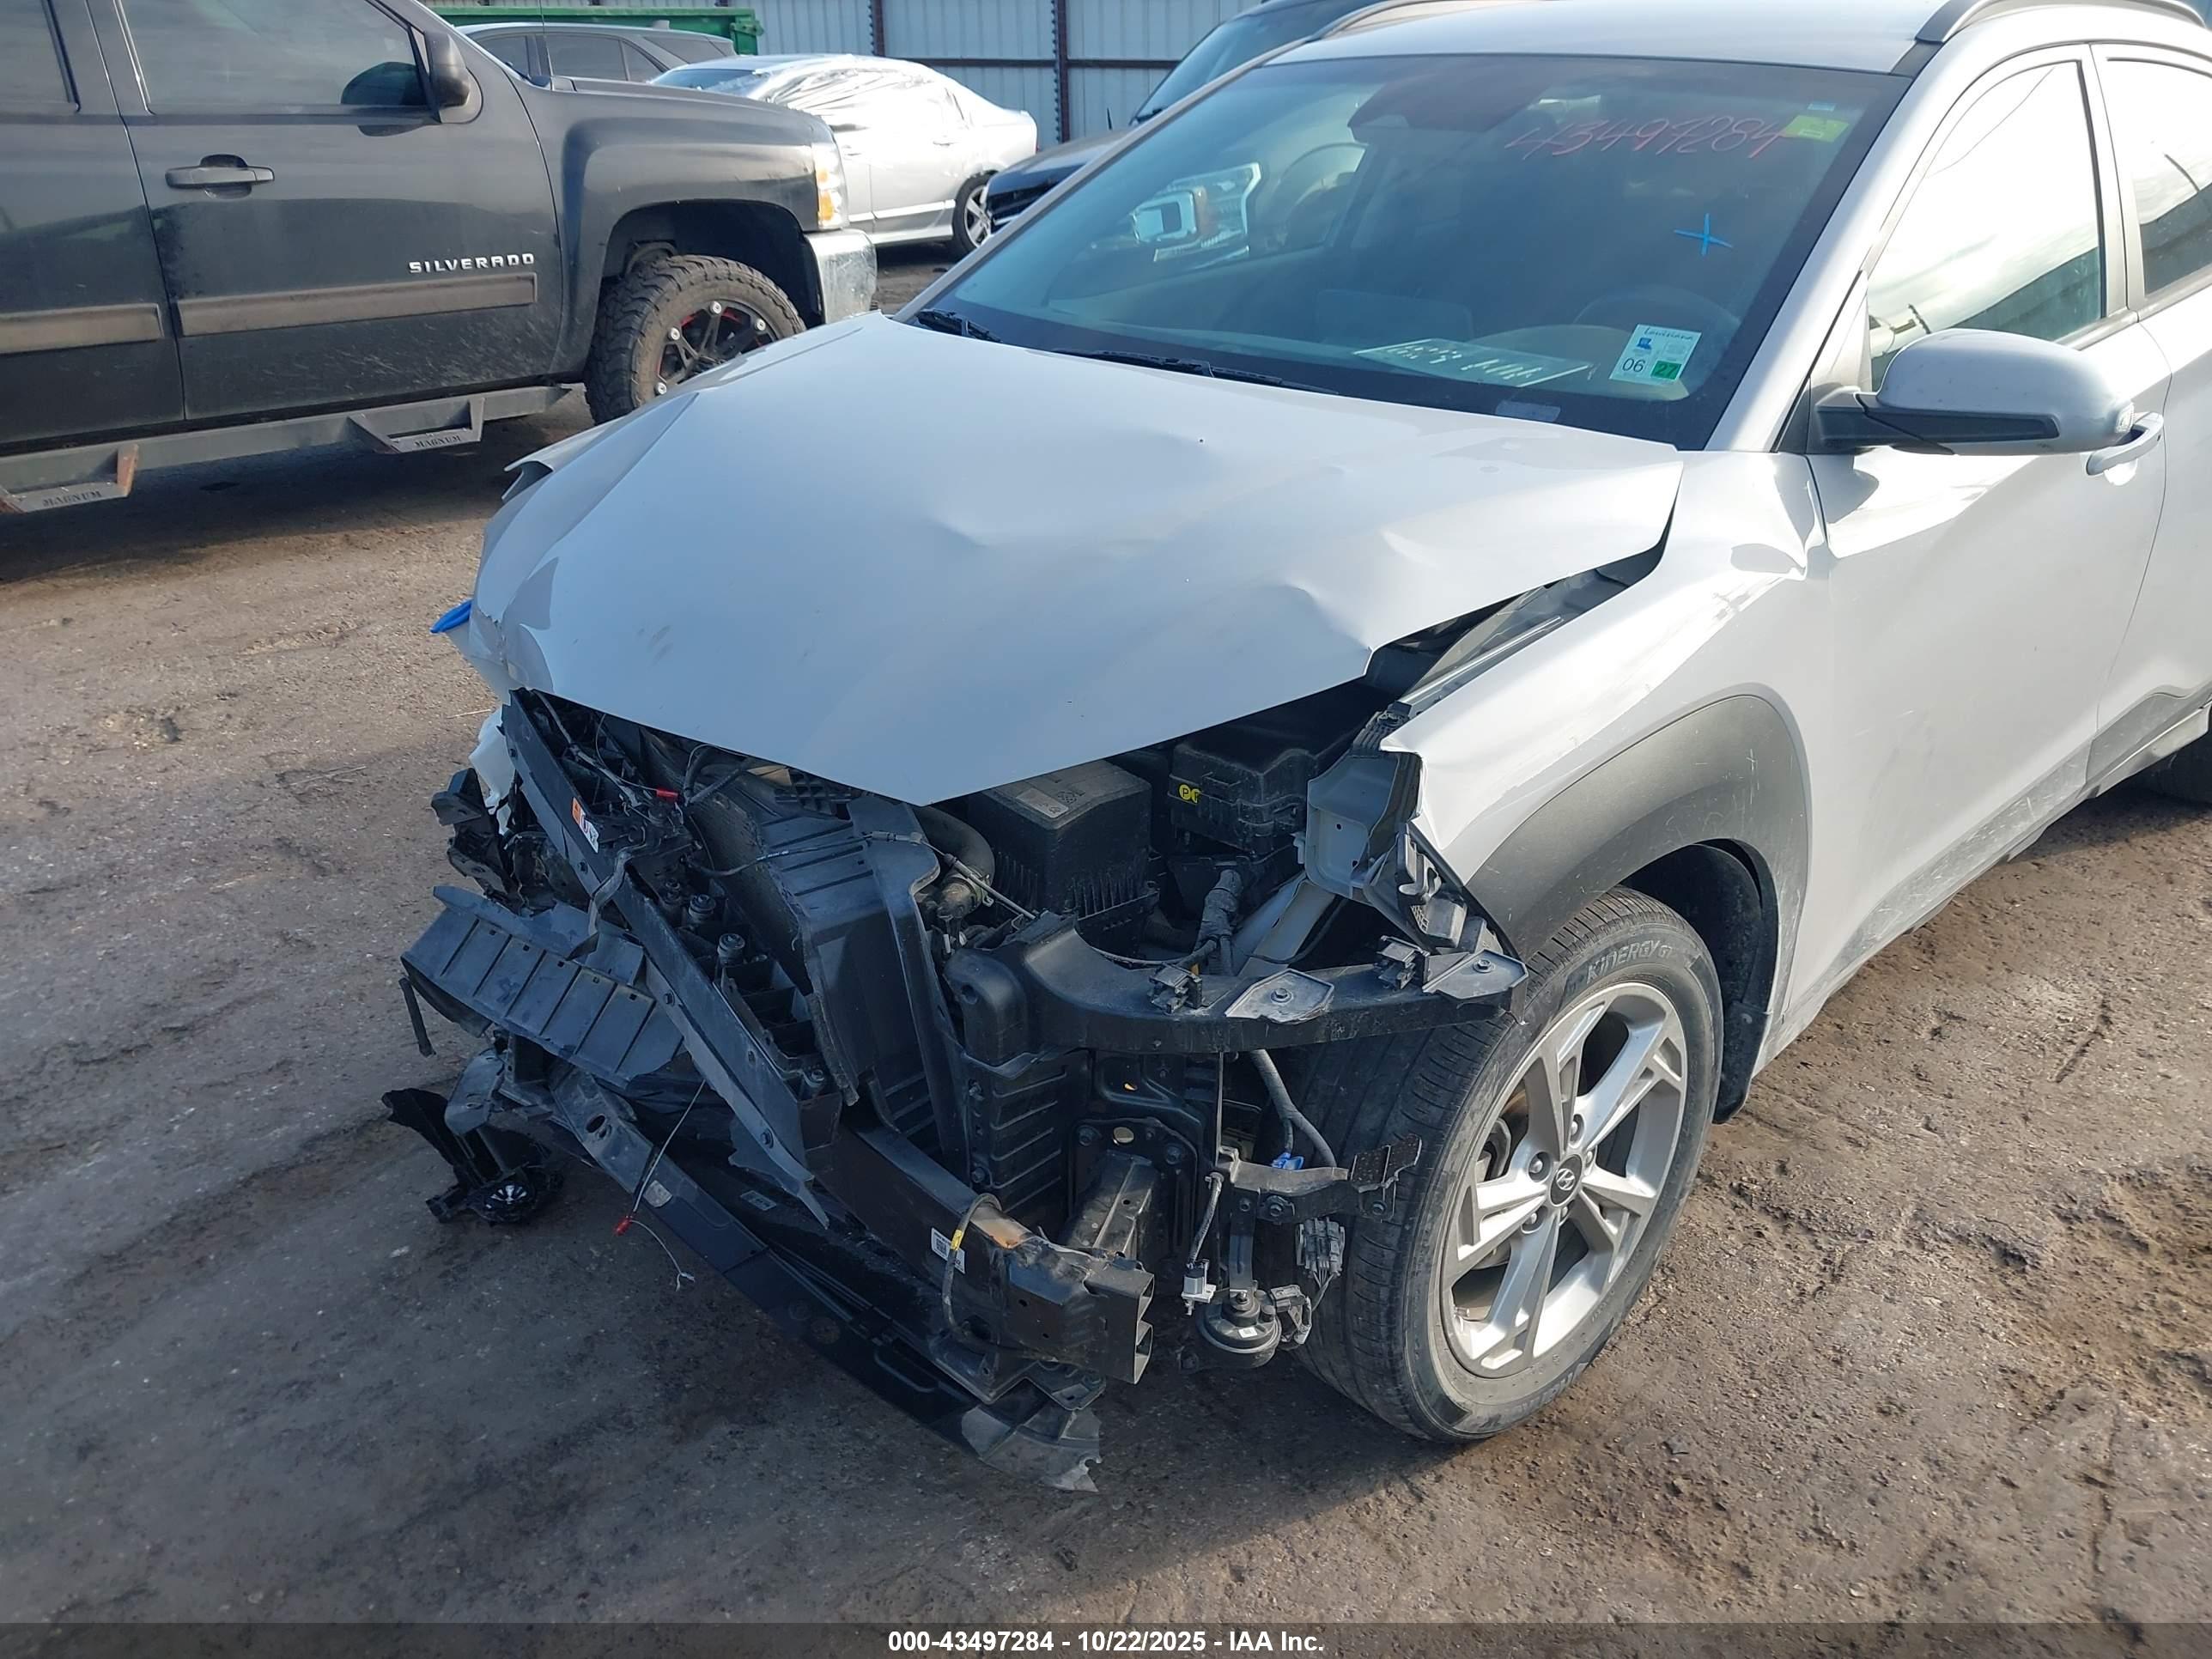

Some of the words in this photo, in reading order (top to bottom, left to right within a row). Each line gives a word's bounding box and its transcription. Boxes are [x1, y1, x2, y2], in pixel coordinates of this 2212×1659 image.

[408, 252, 535, 274] SILVERADO
[1622, 357, 1646, 374] 06
[1654, 364, 1678, 379] 27
[414, 434, 462, 447] MAGNUM
[42, 490, 101, 507] MAGNUM
[1586, 939, 1660, 984] KINERGY
